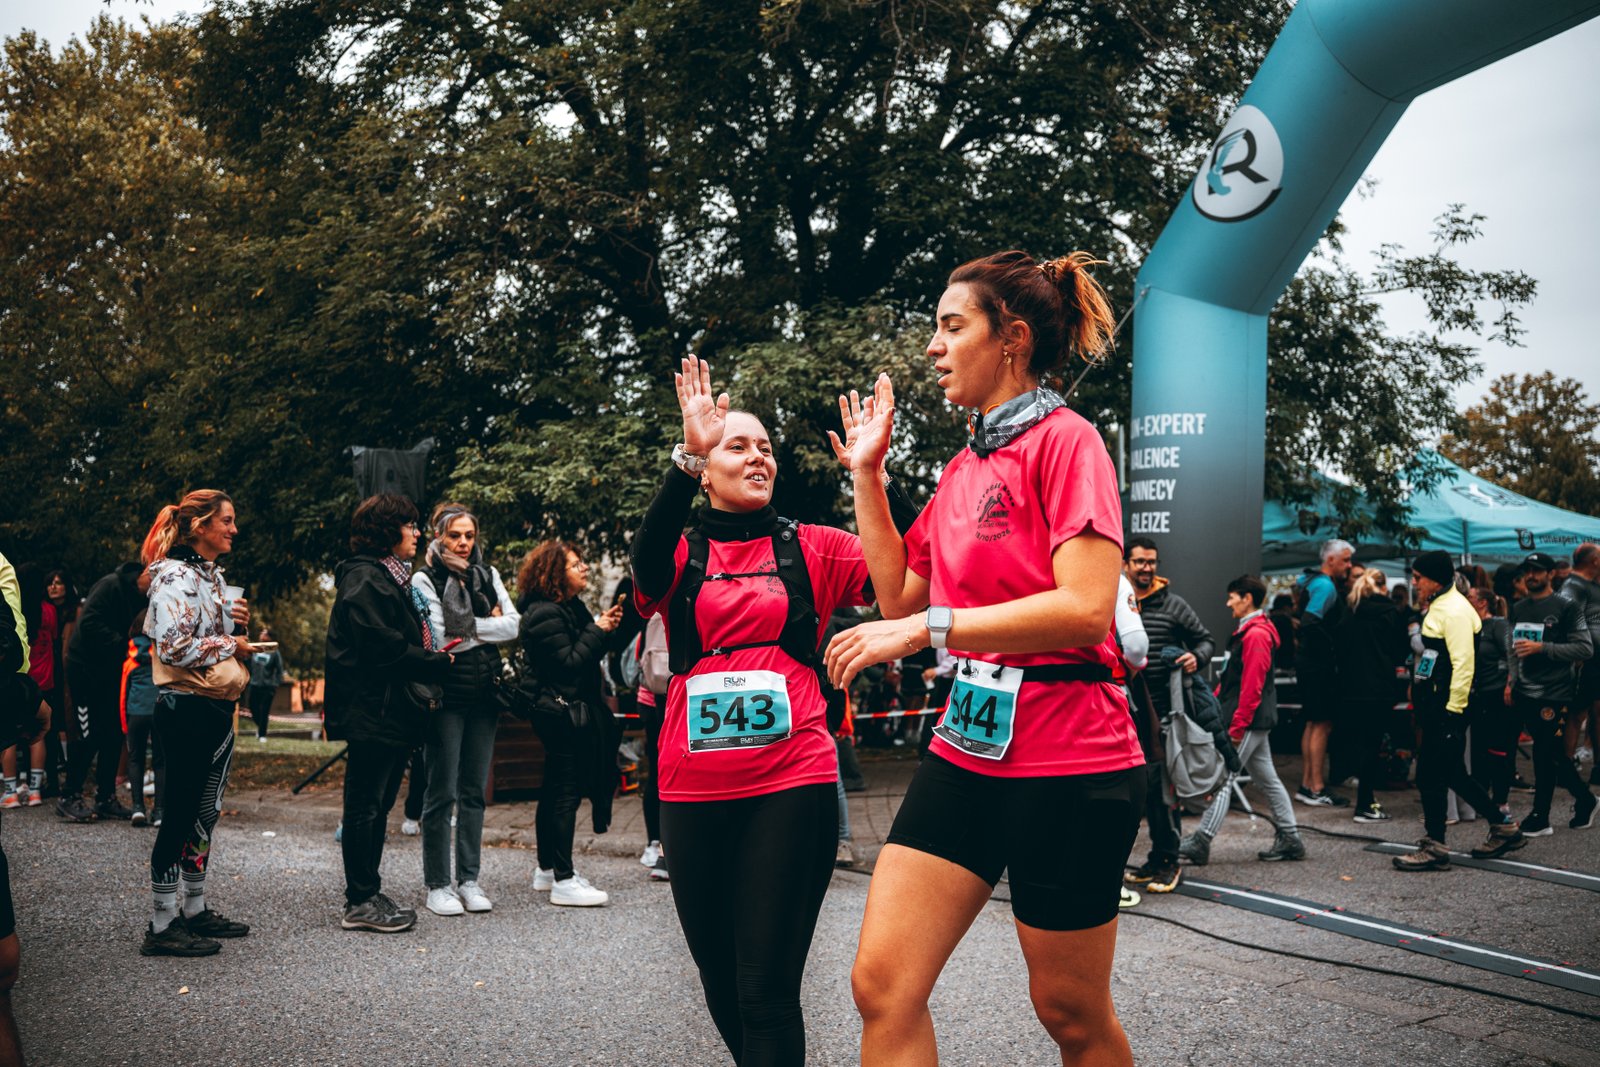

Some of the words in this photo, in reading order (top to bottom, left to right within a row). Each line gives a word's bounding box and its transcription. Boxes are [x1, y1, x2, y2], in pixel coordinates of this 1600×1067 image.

[1131, 479, 1176, 502] ANNECY
[1131, 511, 1171, 533] GLEIZE
[700, 694, 776, 735] 543
[951, 686, 998, 738] 544
